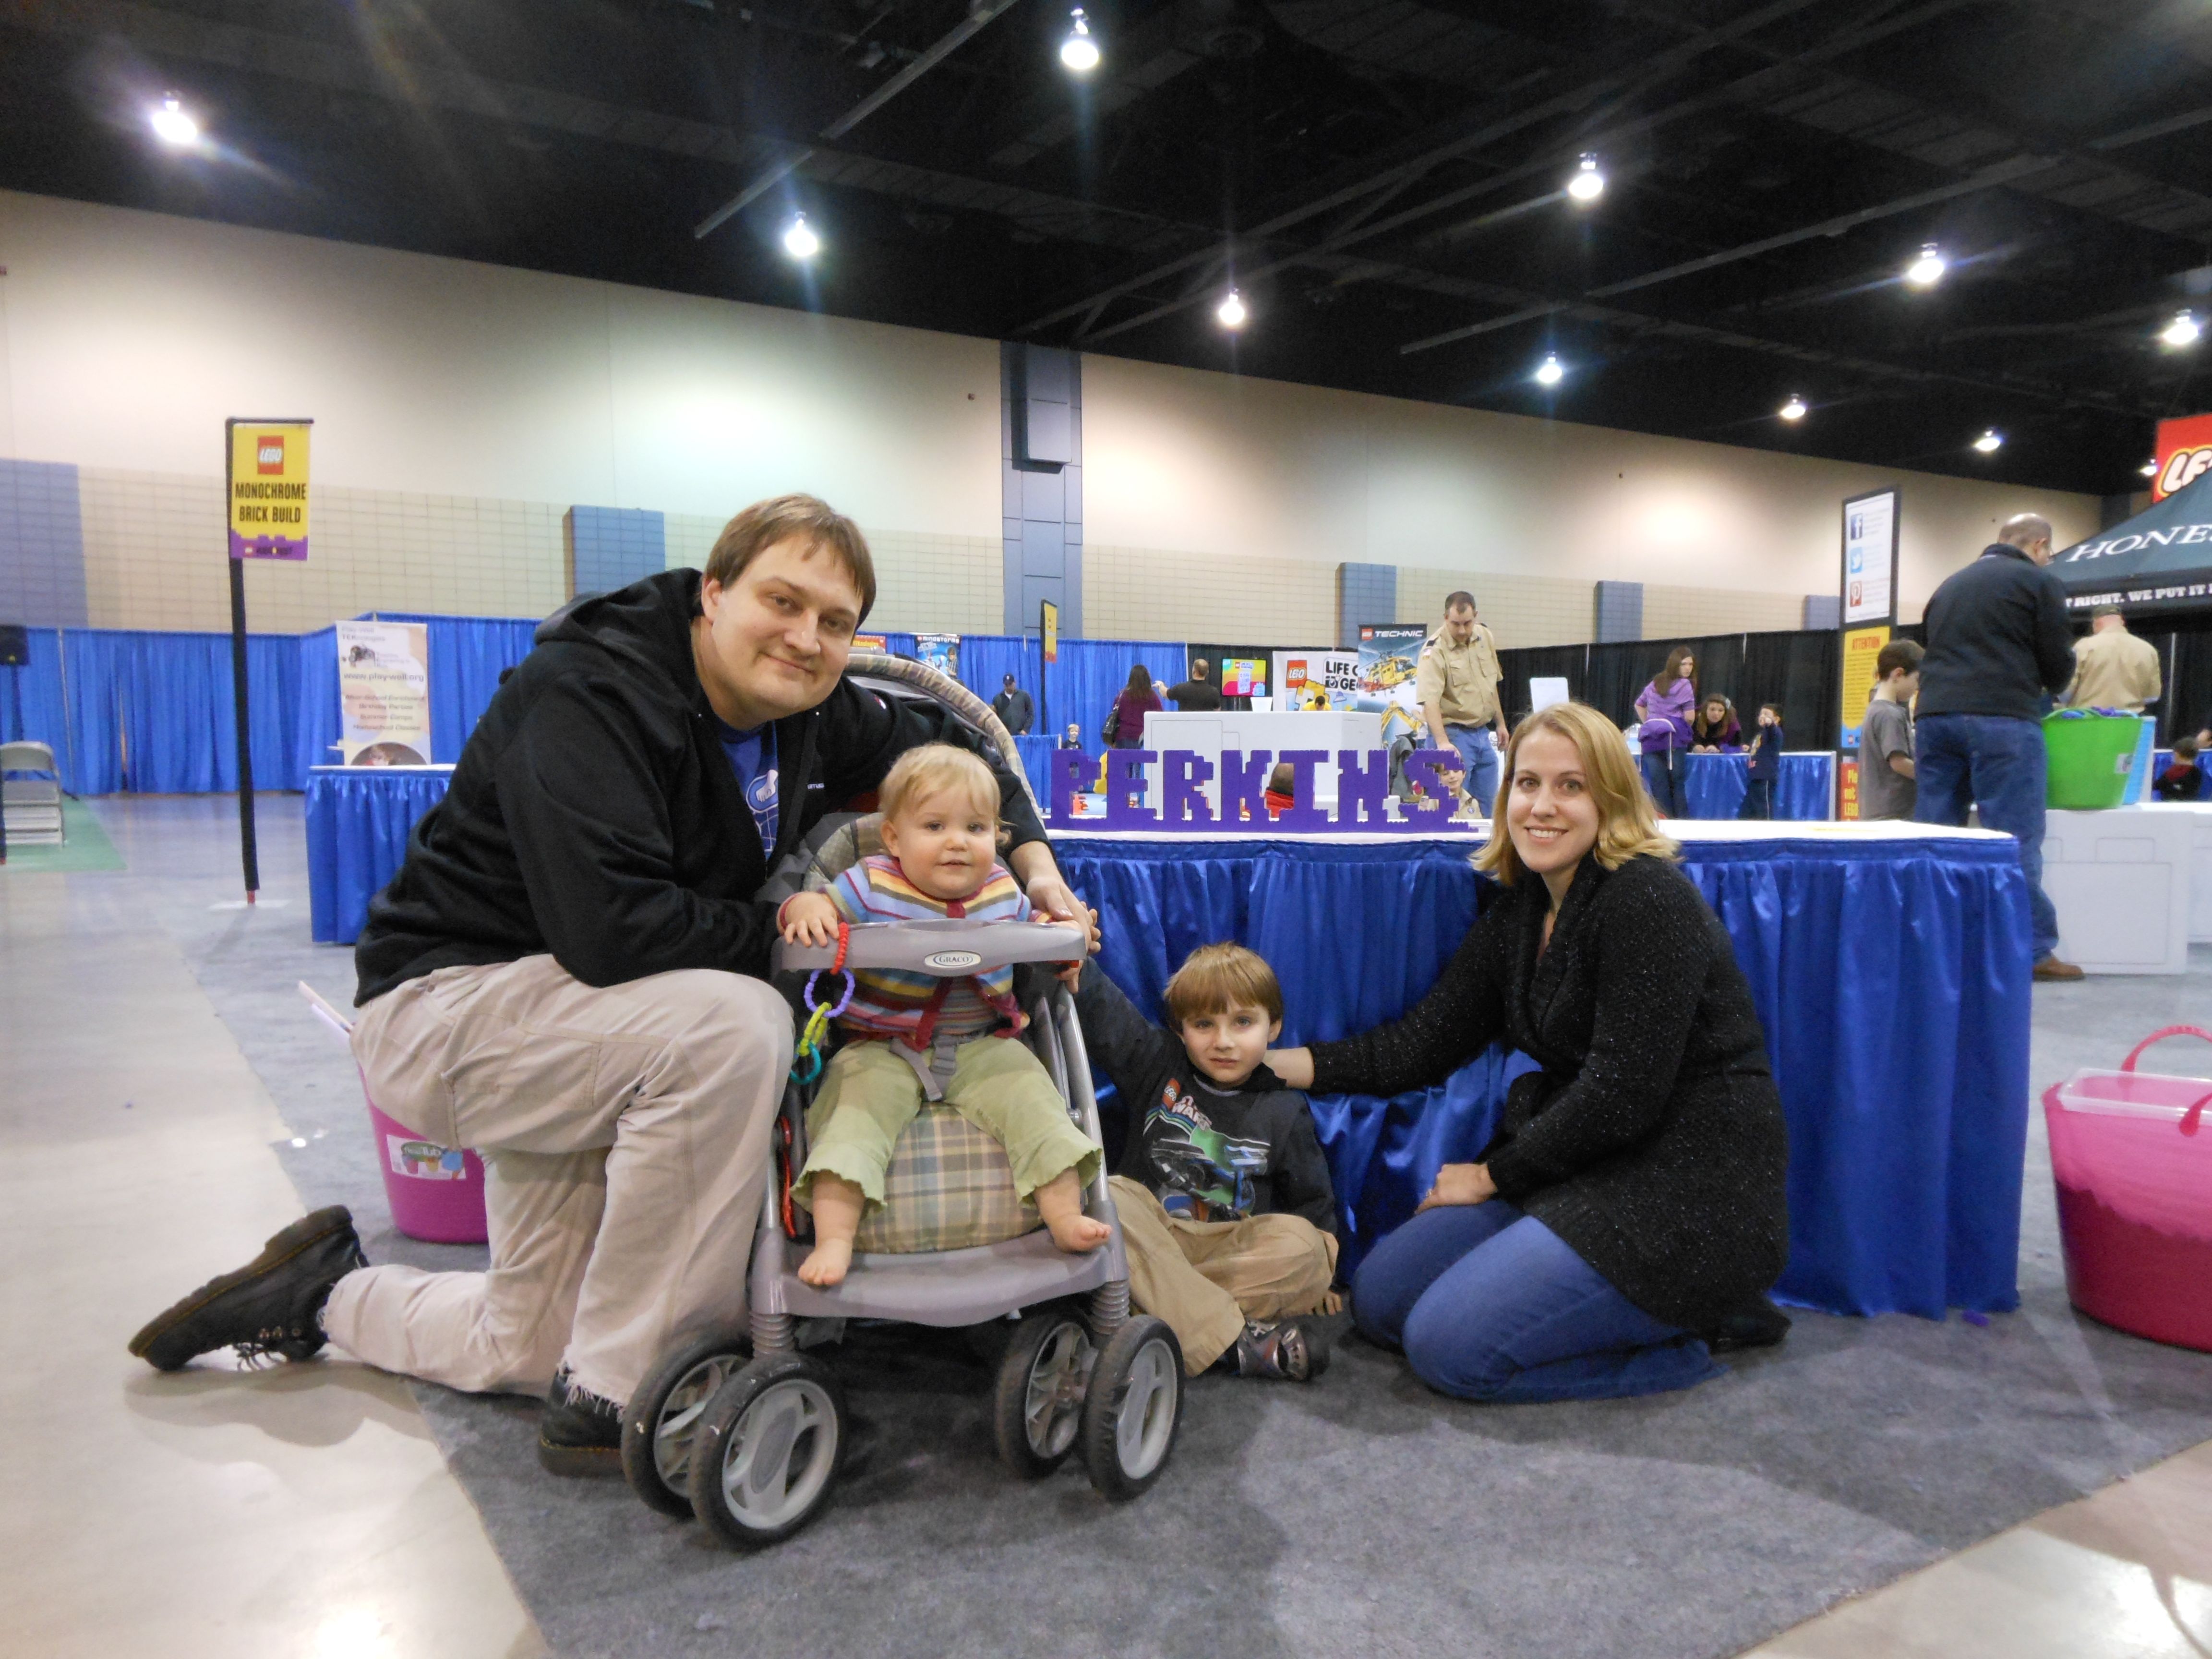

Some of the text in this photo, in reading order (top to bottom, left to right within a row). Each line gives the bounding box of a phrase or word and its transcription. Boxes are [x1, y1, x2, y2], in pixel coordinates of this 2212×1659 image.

[259, 447, 283, 464] LEGO
[235, 482, 307, 500] MONOCHROME
[239, 506, 301, 523] BRICK BUILD
[2066, 524, 2212, 563] HONE
[2074, 592, 2125, 607] RIGHT.
[2128, 589, 2152, 602] WE
[2155, 586, 2187, 599] PUT
[2188, 584, 2206, 596] IT
[1288, 668, 1306, 680] LEGO
[1325, 661, 1349, 675] LIFE
[1050, 749, 1466, 822] PERKINS
[1164, 1086, 1177, 1102] LEGO
